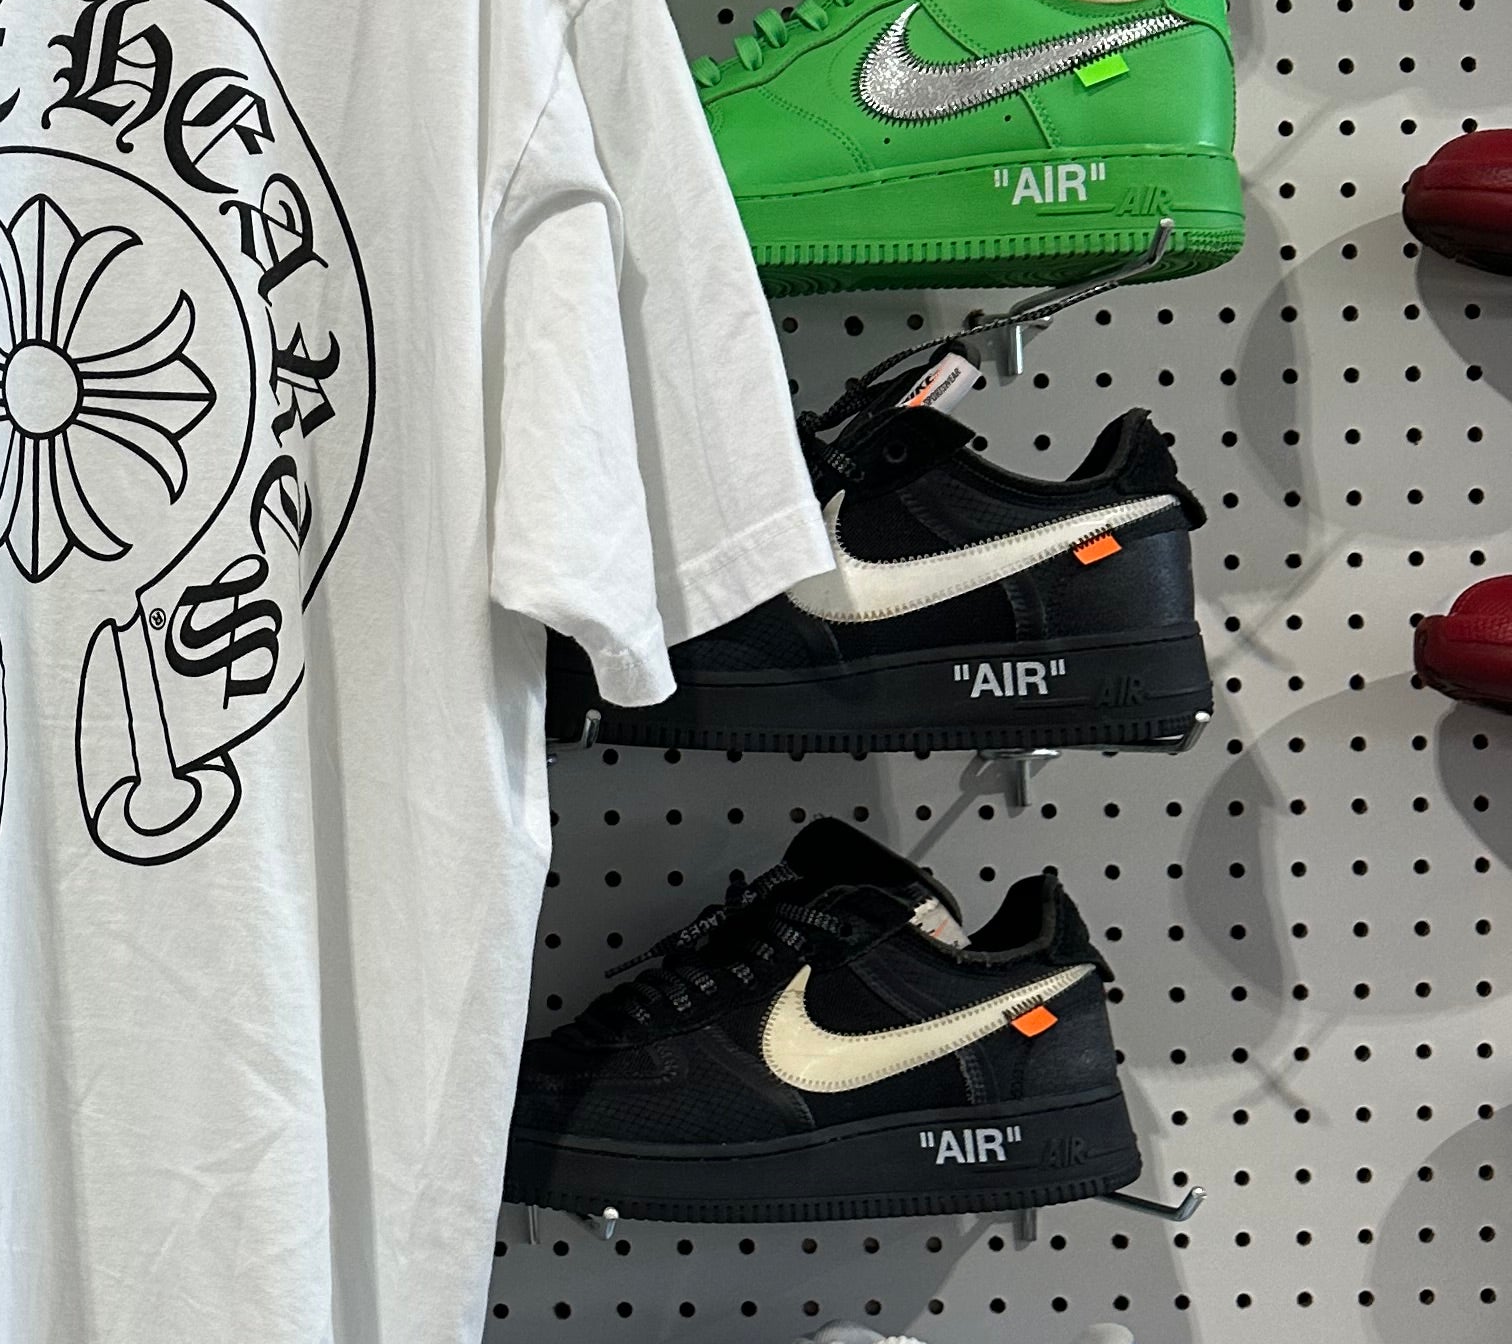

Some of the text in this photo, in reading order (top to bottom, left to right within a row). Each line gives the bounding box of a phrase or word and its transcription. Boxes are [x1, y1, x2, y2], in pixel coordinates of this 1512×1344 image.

[993, 162, 1106, 205] "AIR"
[953, 658, 1066, 698] "AIR"
[919, 1125, 1022, 1165] "AIR"
